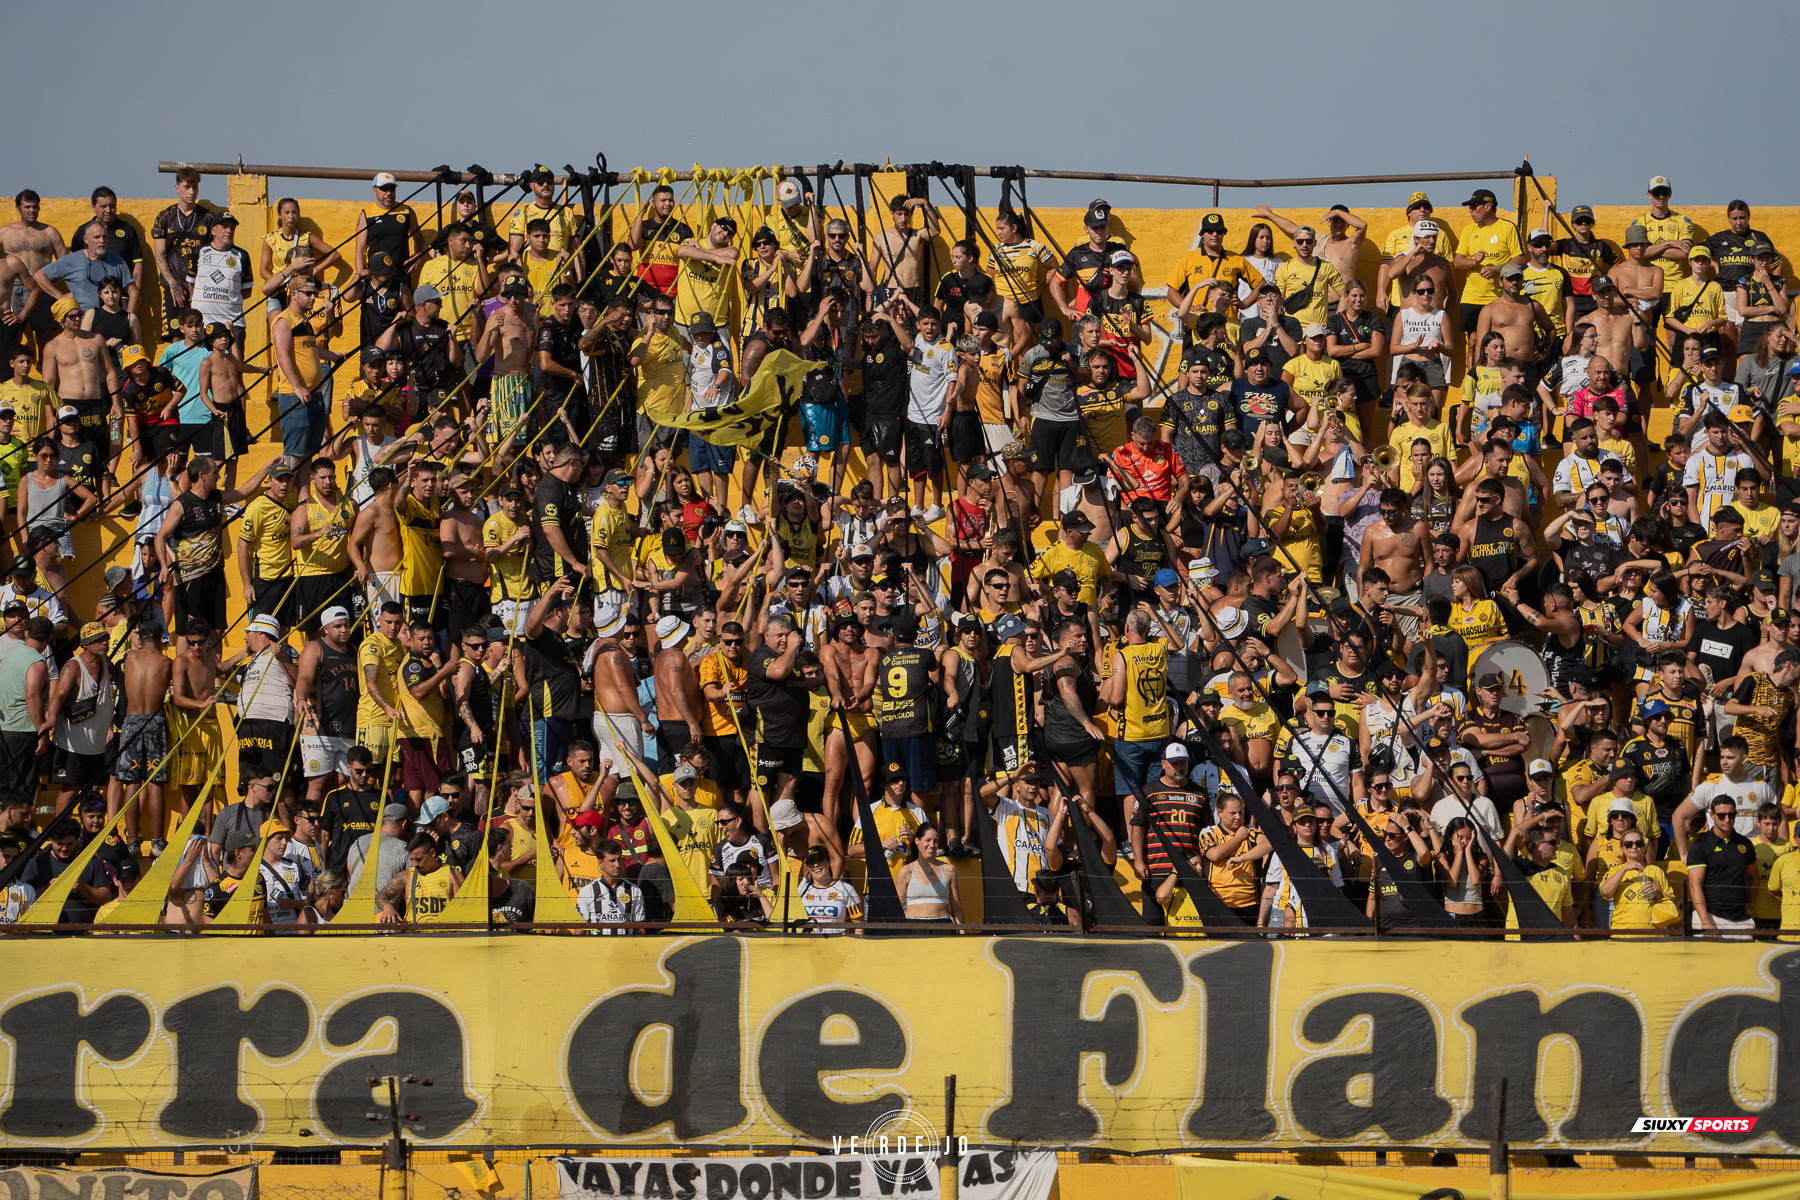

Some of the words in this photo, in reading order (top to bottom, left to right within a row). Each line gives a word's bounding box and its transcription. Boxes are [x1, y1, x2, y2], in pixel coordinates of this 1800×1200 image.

[440, 285, 473, 293] CANARIO
[203, 291, 230, 302] Cortines
[1403, 319, 1430, 328] thank
[891, 658, 920, 667] Cortines
[886, 666, 908, 698] 9
[71, 711, 96, 724] FILA
[1170, 809, 1186, 824] 20
[596, 913, 631, 922] CANARIO
[1, 985, 480, 1141] rra
[566, 935, 907, 1142] de
[992, 939, 1800, 1146] Fland
[704, 1160, 862, 1200] DONDE
[874, 1151, 1018, 1197] VAAS
